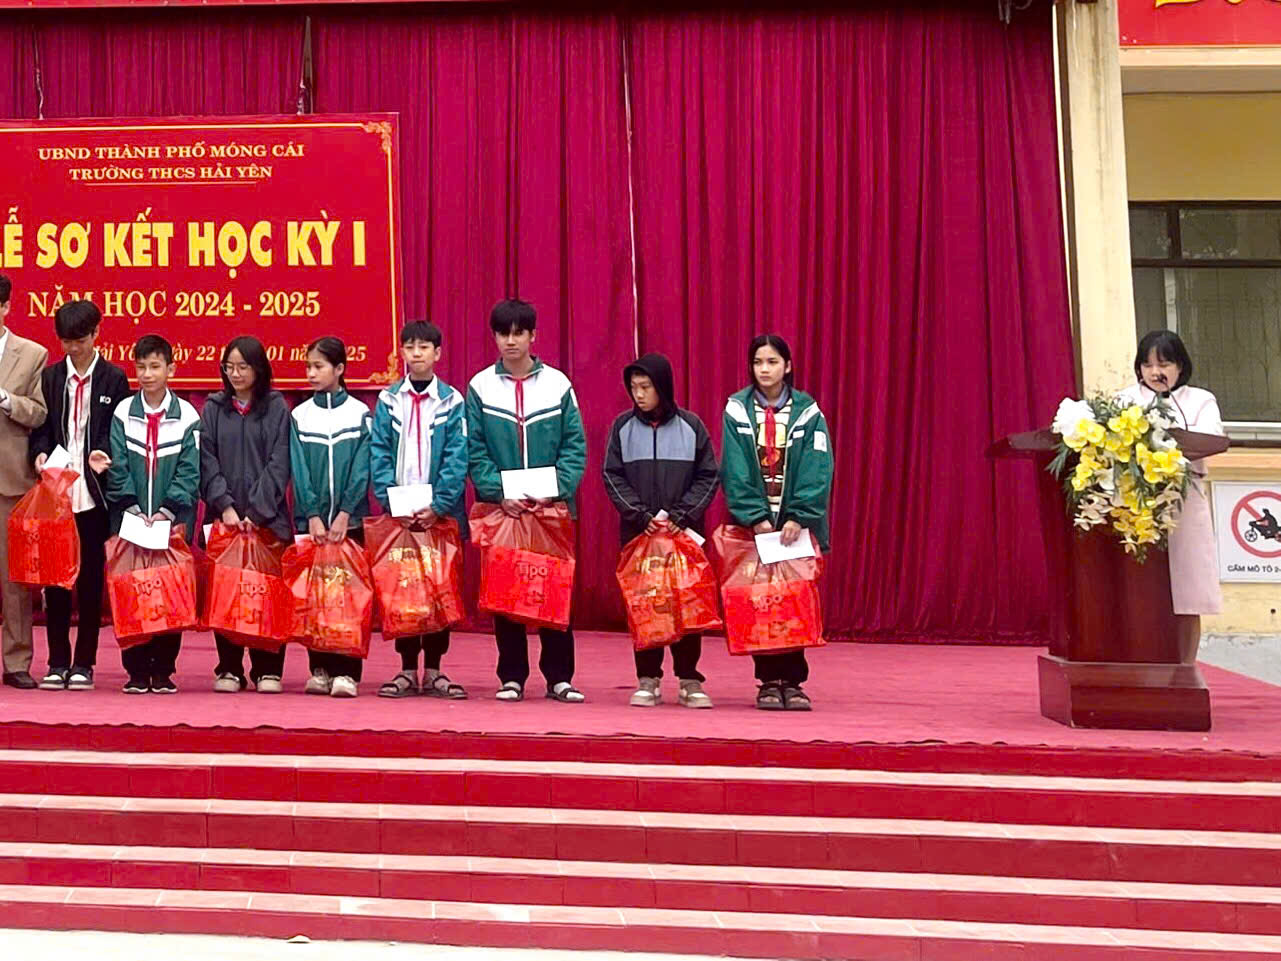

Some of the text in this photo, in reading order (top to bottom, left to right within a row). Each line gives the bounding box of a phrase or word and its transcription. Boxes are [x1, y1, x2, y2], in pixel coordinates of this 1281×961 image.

[38, 140, 305, 160] UBND THÀNH PHỐ MÓNG CÁI
[69, 162, 273, 181] TRƯỜNG THCS HẢI YÊN
[36, 221, 91, 269] SƠ
[103, 206, 174, 268] KẾT
[187, 220, 273, 279] HỌC
[287, 210, 341, 267] KỲ
[352, 220, 366, 267] I
[103, 290, 167, 325] HỌC
[175, 291, 236, 317] 2024
[259, 291, 321, 317] 2025
[195, 345, 216, 361] 22
[266, 345, 284, 362] 01
[346, 345, 367, 362] 25
